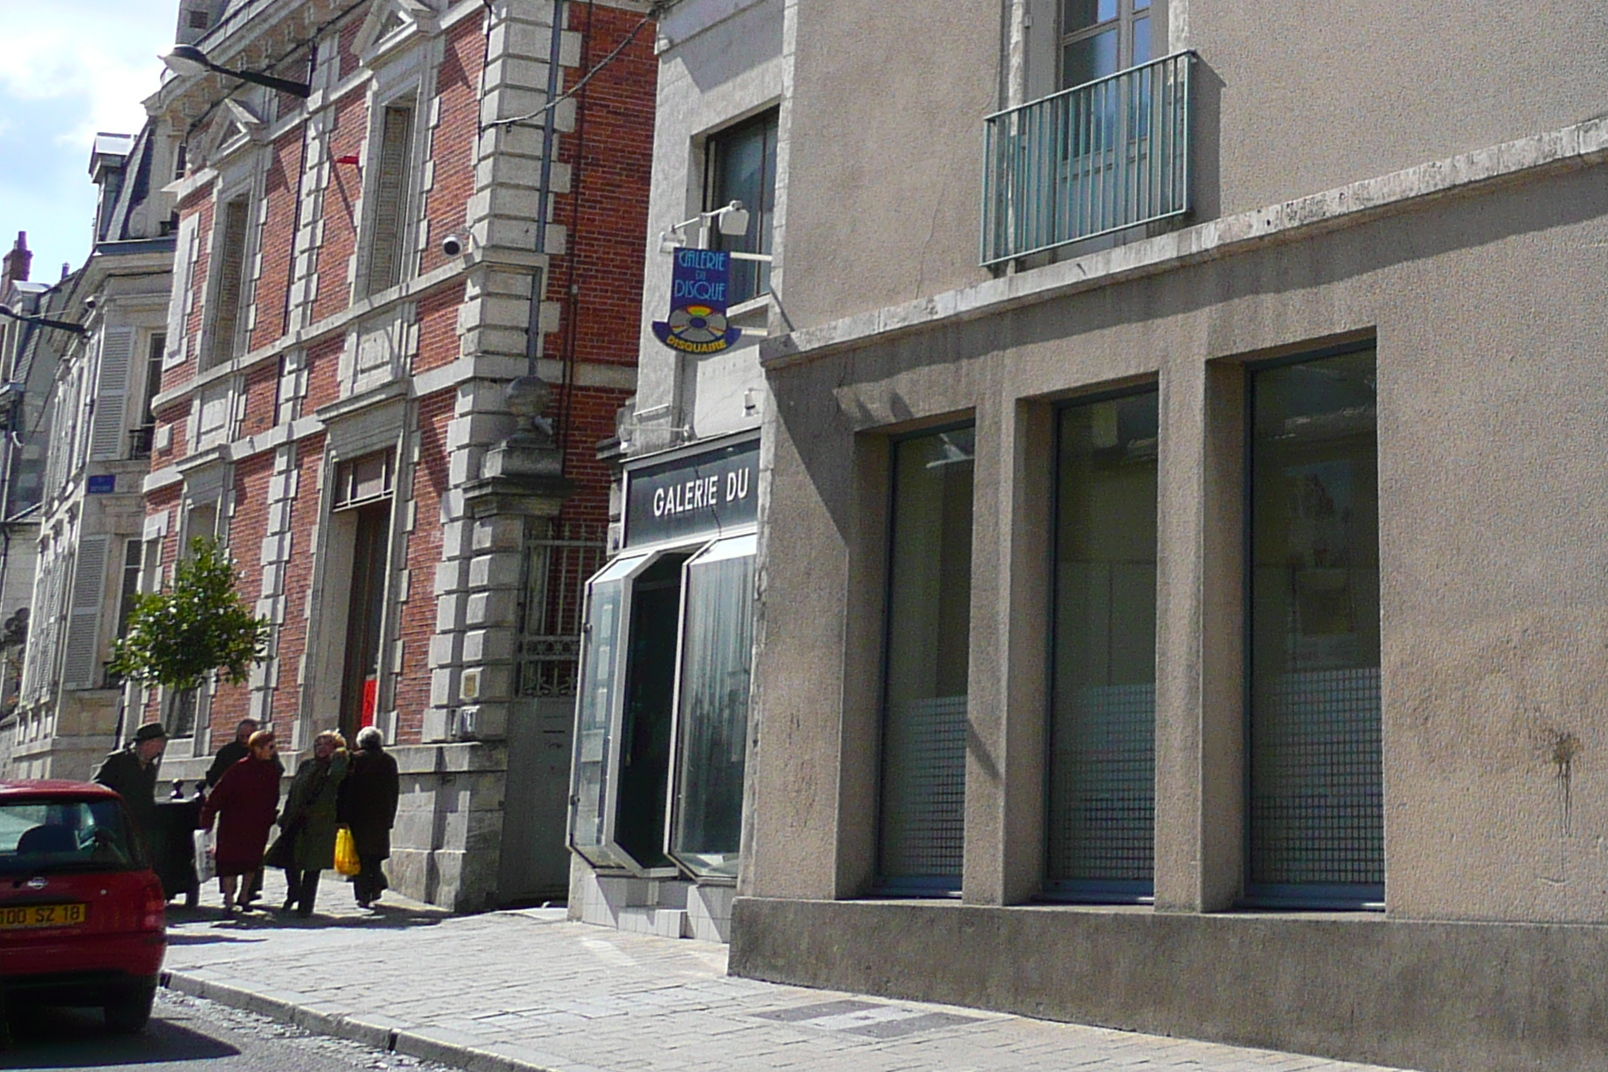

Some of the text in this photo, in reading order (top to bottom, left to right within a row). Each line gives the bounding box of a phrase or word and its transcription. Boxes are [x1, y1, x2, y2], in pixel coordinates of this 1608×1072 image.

[678, 249, 725, 271] GALERIE
[695, 270, 706, 280] DU
[674, 279, 726, 301] DISQUE
[666, 335, 727, 353] DISQUAIRE
[653, 467, 749, 517] GALERIE DU
[35, 907, 55, 922] SZ
[63, 906, 80, 921] 18
